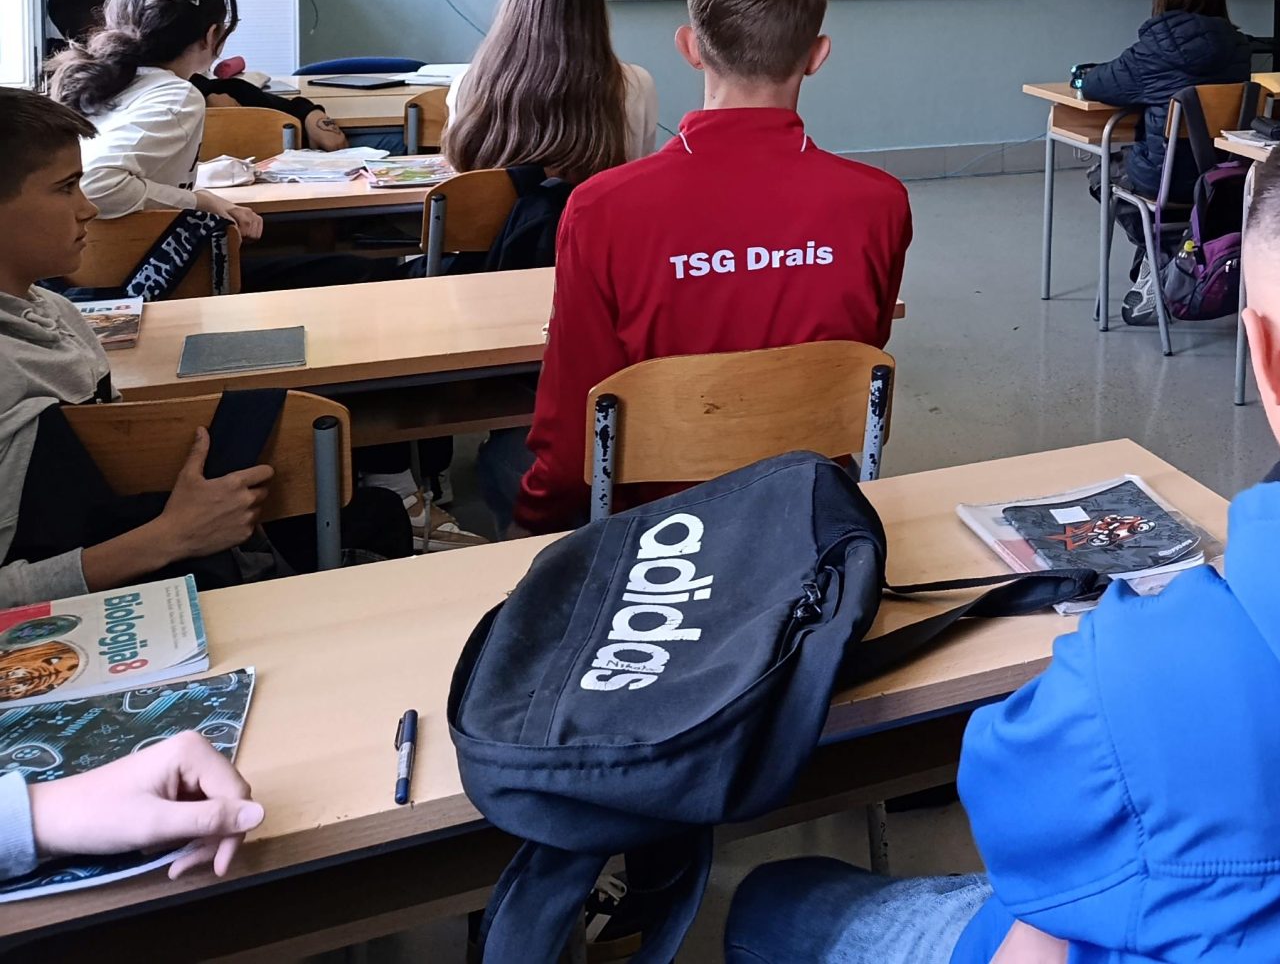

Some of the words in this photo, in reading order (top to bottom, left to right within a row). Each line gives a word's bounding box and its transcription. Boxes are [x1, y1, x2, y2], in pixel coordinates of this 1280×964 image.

[669, 249, 735, 279] TSG
[747, 241, 833, 271] Drais
[580, 512, 714, 692] adidas
